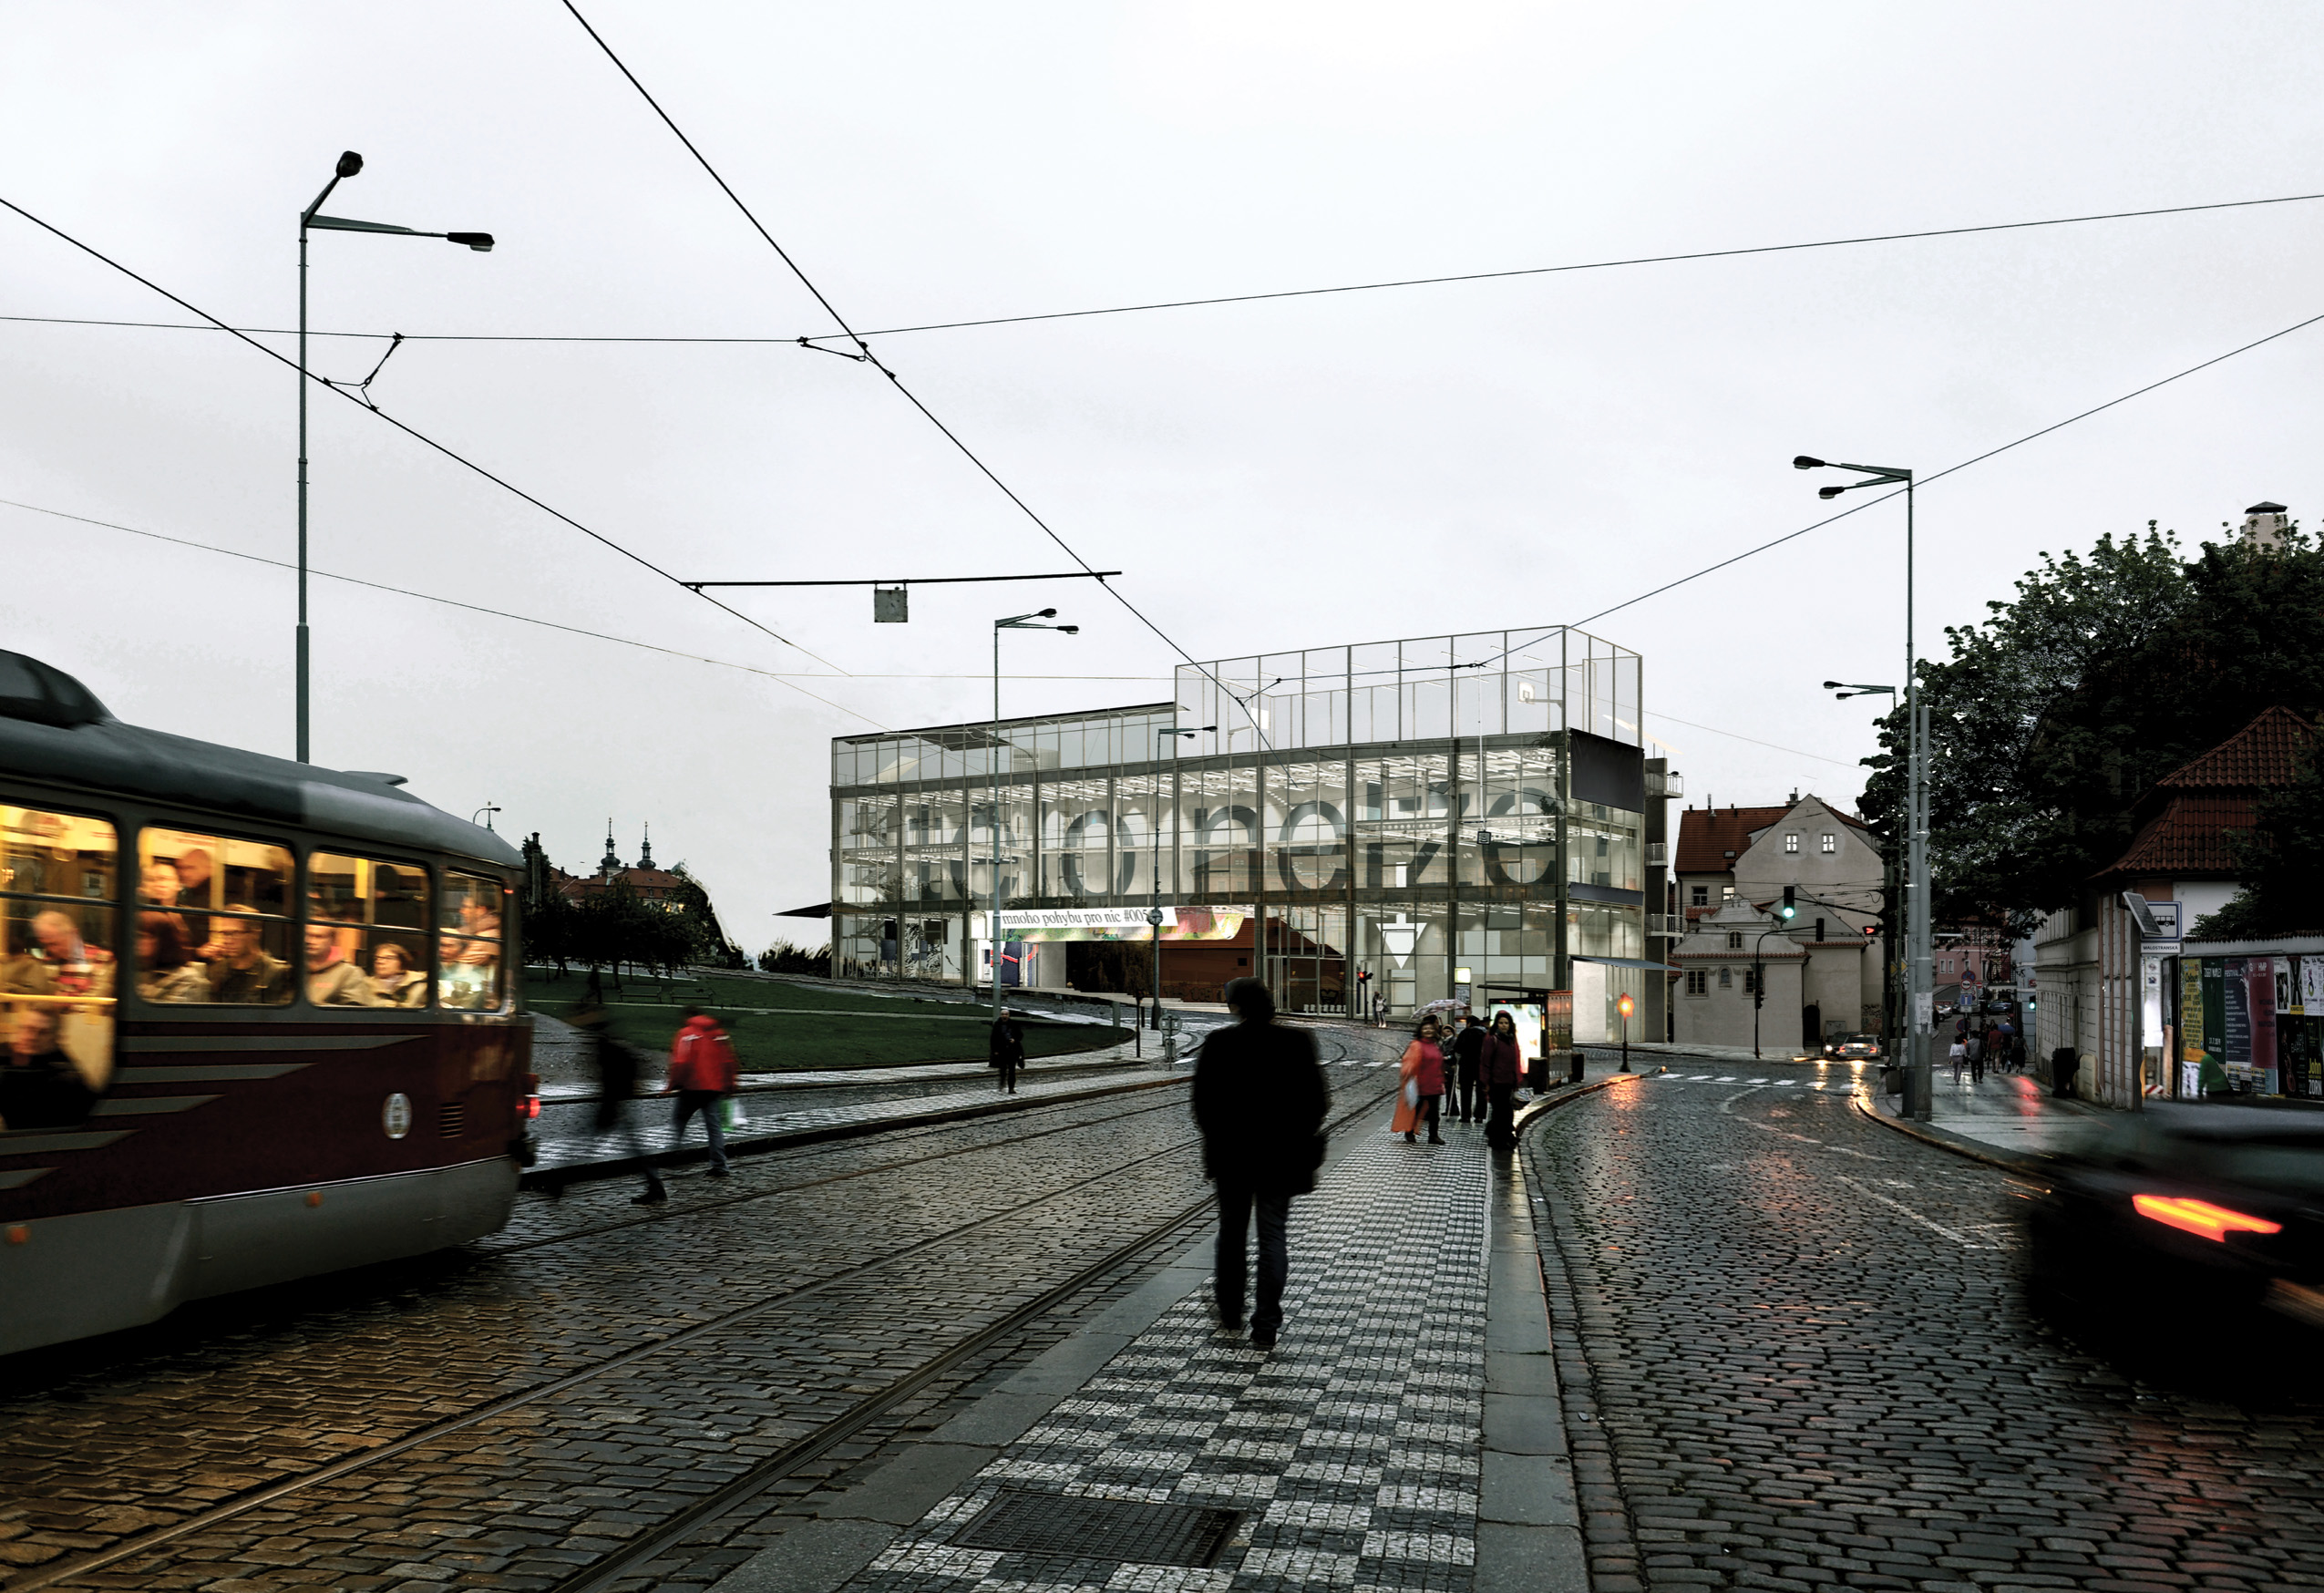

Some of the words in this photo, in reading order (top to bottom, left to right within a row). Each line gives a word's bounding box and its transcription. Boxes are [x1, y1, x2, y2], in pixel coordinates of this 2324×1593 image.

[1003, 911, 1040, 925] mnoho
[1042, 910, 1083, 926] pohybu
[1086, 913, 1103, 926] pro
[1105, 910, 1121, 923] nic
[2309, 1057, 2322, 1074] John
[2309, 1079, 2323, 1095] ZORN
